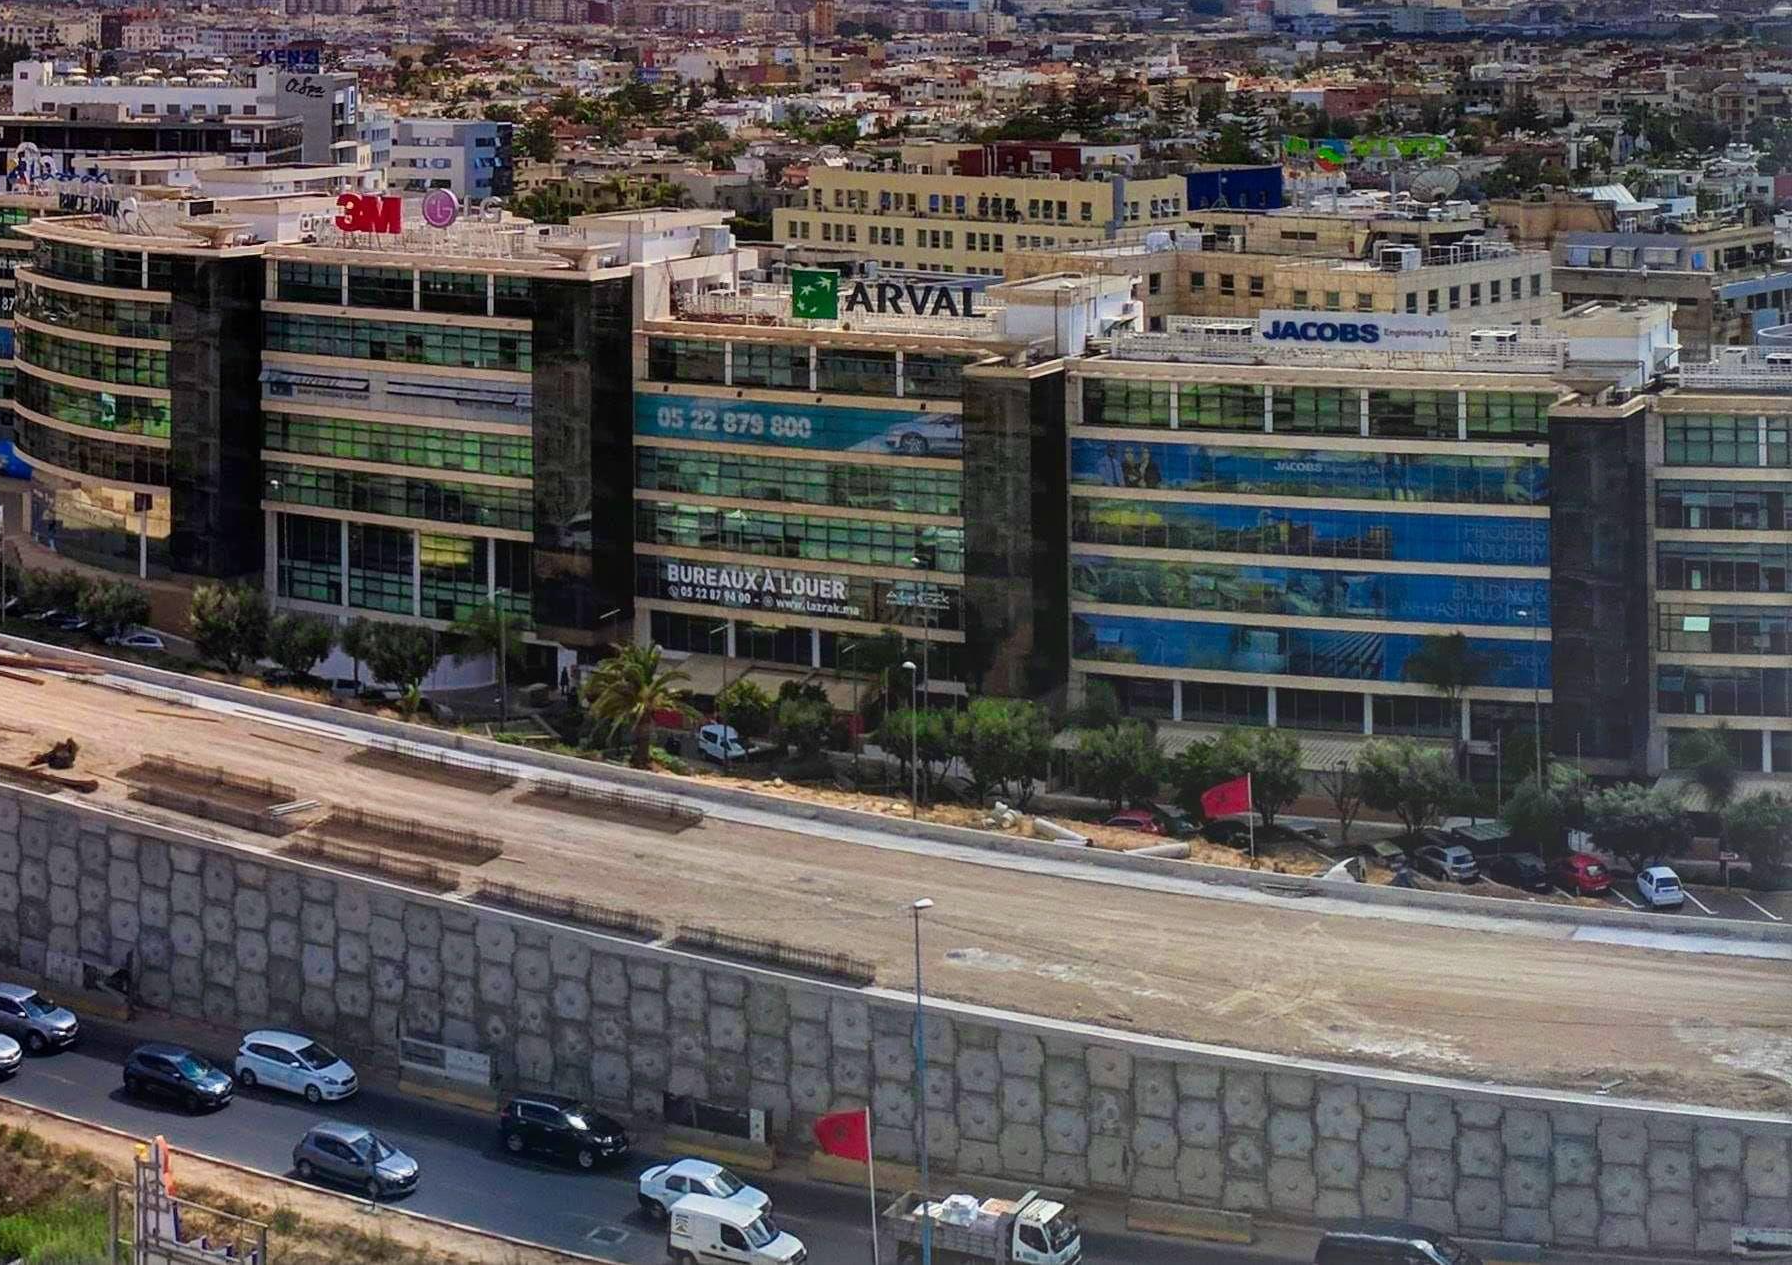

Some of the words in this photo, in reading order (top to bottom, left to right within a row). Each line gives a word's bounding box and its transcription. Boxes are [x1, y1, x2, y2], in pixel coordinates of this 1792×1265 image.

[90, 196, 121, 217] BANK
[334, 192, 403, 234] 3M
[1, 297, 15, 311] 87
[846, 282, 986, 318] ARVAL
[1263, 320, 1380, 343] JACOBS
[1384, 328, 1433, 339] Engineering
[657, 407, 683, 429] 05
[690, 408, 718, 432] 22
[723, 413, 764, 434] 879
[1273, 461, 1323, 472] JACOBS
[1463, 542, 1547, 559] INDUSTRY
[667, 563, 760, 592] BUREAUX
[762, 568, 777, 593] À
[780, 575, 846, 600] LOUER
[681, 585, 693, 598] 05
[695, 587, 708, 599] 22
[709, 589, 721, 601] 87
[724, 591, 736, 603] 94
[776, 597, 860, 617] www.lazrak.ma
[1452, 584, 1533, 604] BUILDING
